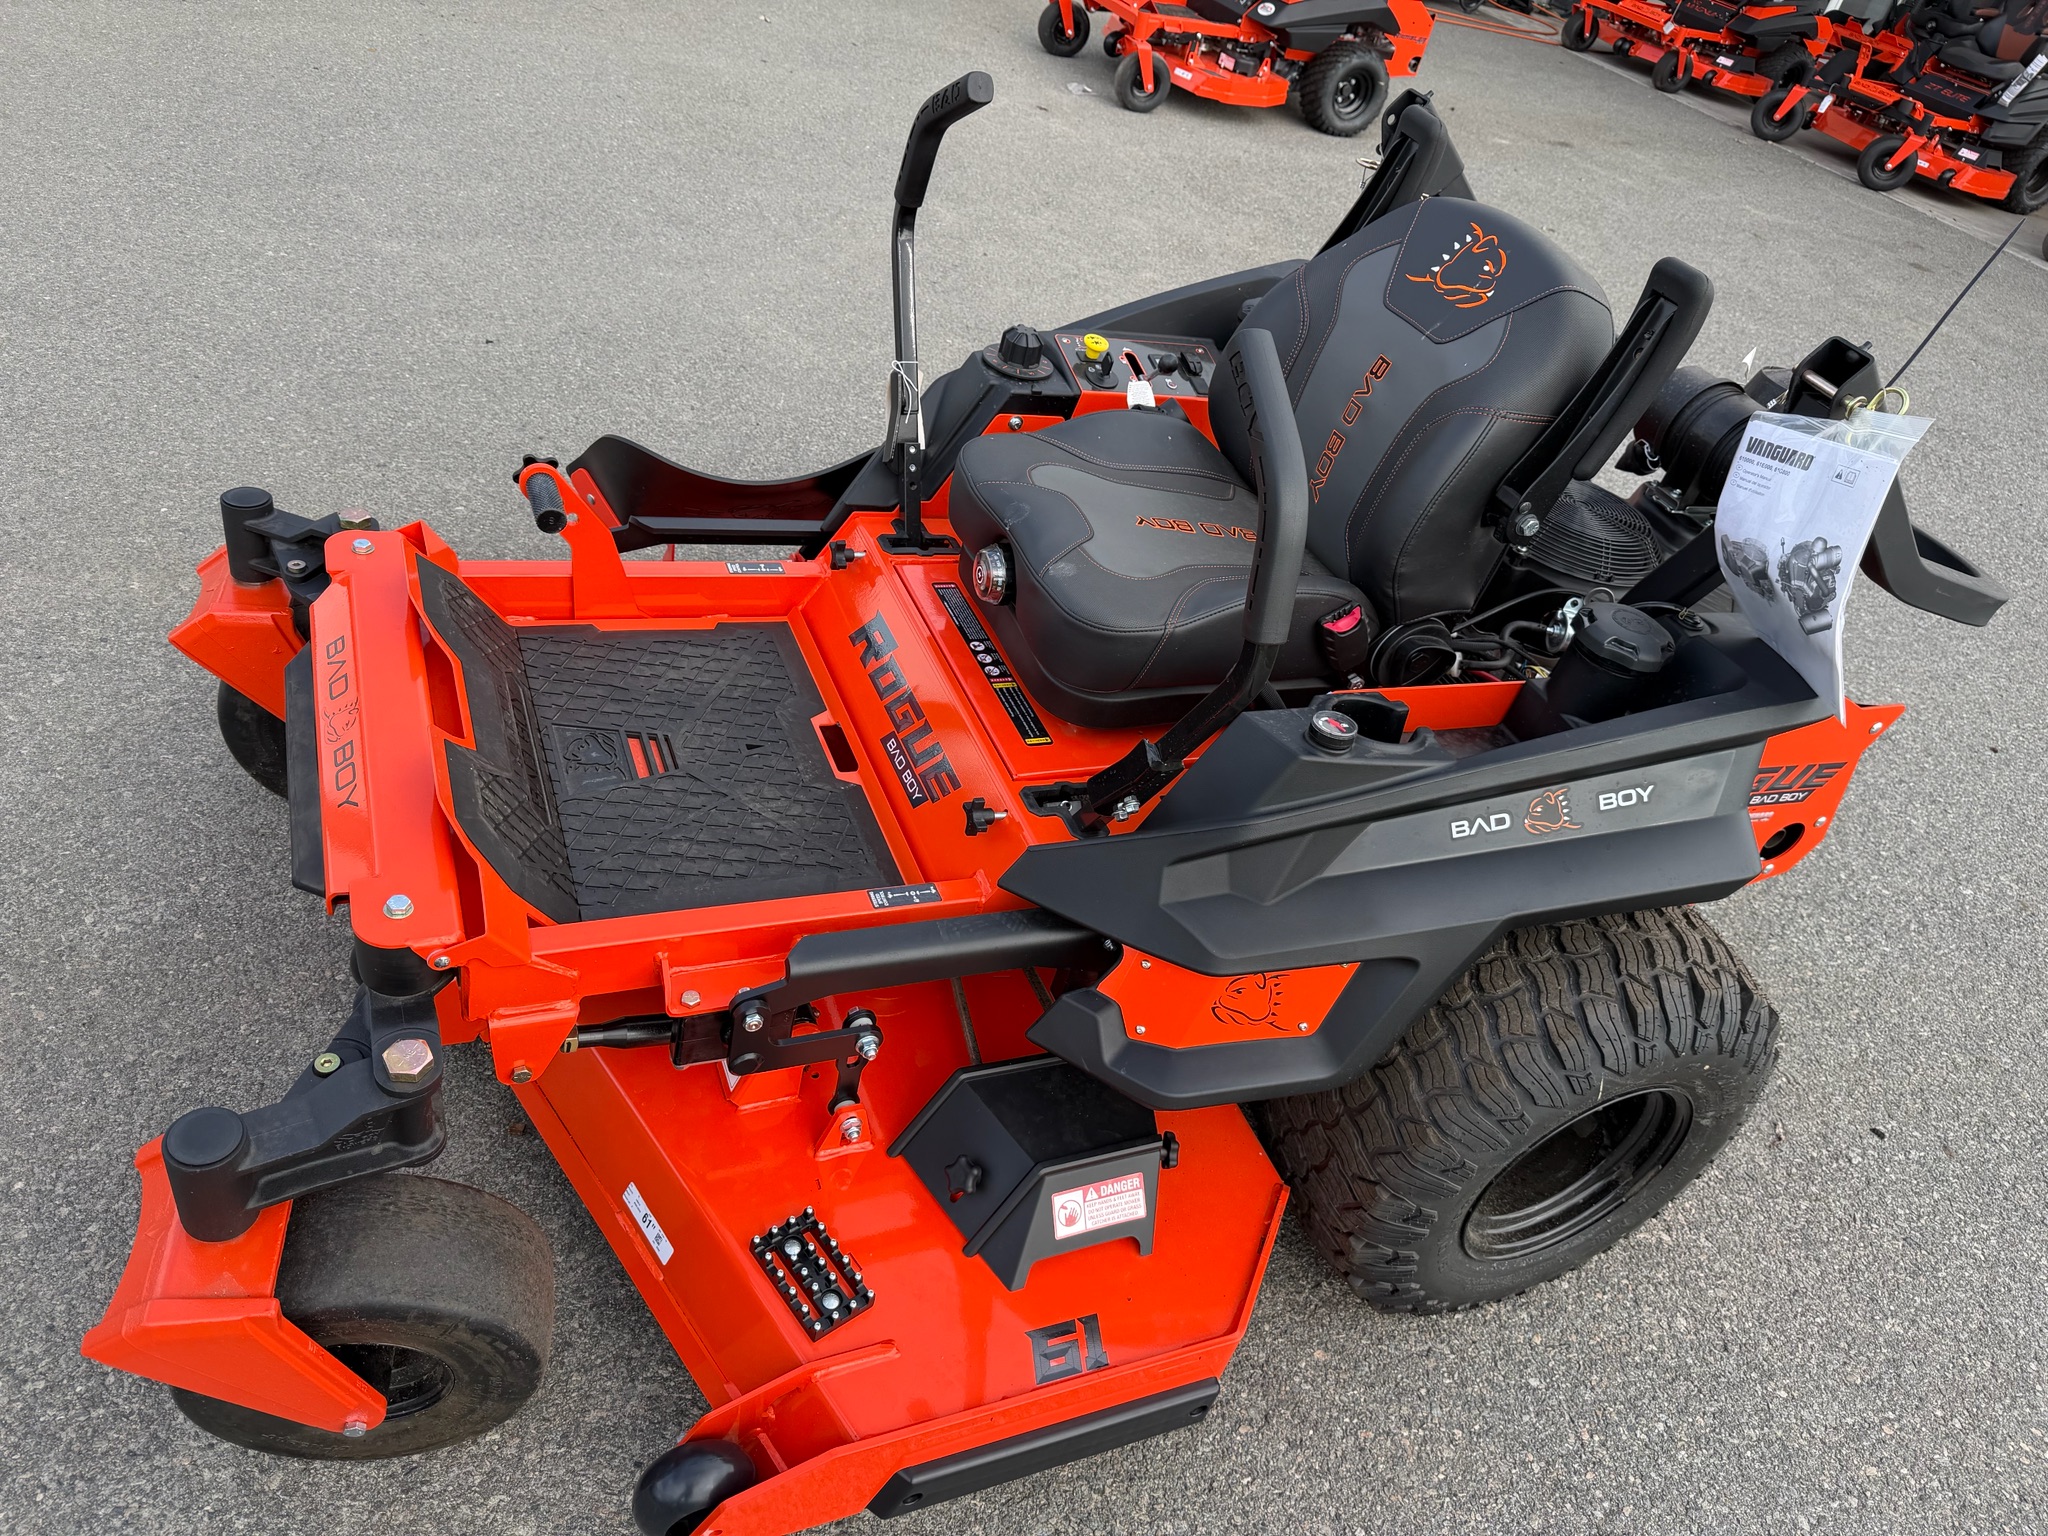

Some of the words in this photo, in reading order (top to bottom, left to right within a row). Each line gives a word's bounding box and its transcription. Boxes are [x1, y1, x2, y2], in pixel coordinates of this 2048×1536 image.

[1341, 353, 1392, 427] BAD
[1309, 428, 1346, 504] BOY
[1745, 436, 1815, 471] VANGUARD
[1135, 515, 1196, 534] BOY
[1197, 521, 1257, 542] BAD
[326, 635, 349, 701] BAD
[848, 609, 962, 804] ROGUE
[333, 740, 359, 808] BOY
[886, 737, 907, 771] BAD
[902, 768, 922, 800] BOY
[1749, 793, 1779, 805] BAD
[1778, 791, 1808, 803] BOY
[1450, 813, 1511, 839] BAD
[1598, 785, 1655, 811] BOY
[1100, 1177, 1140, 1196] DANGER
[1024, 1313, 1110, 1385] 61
